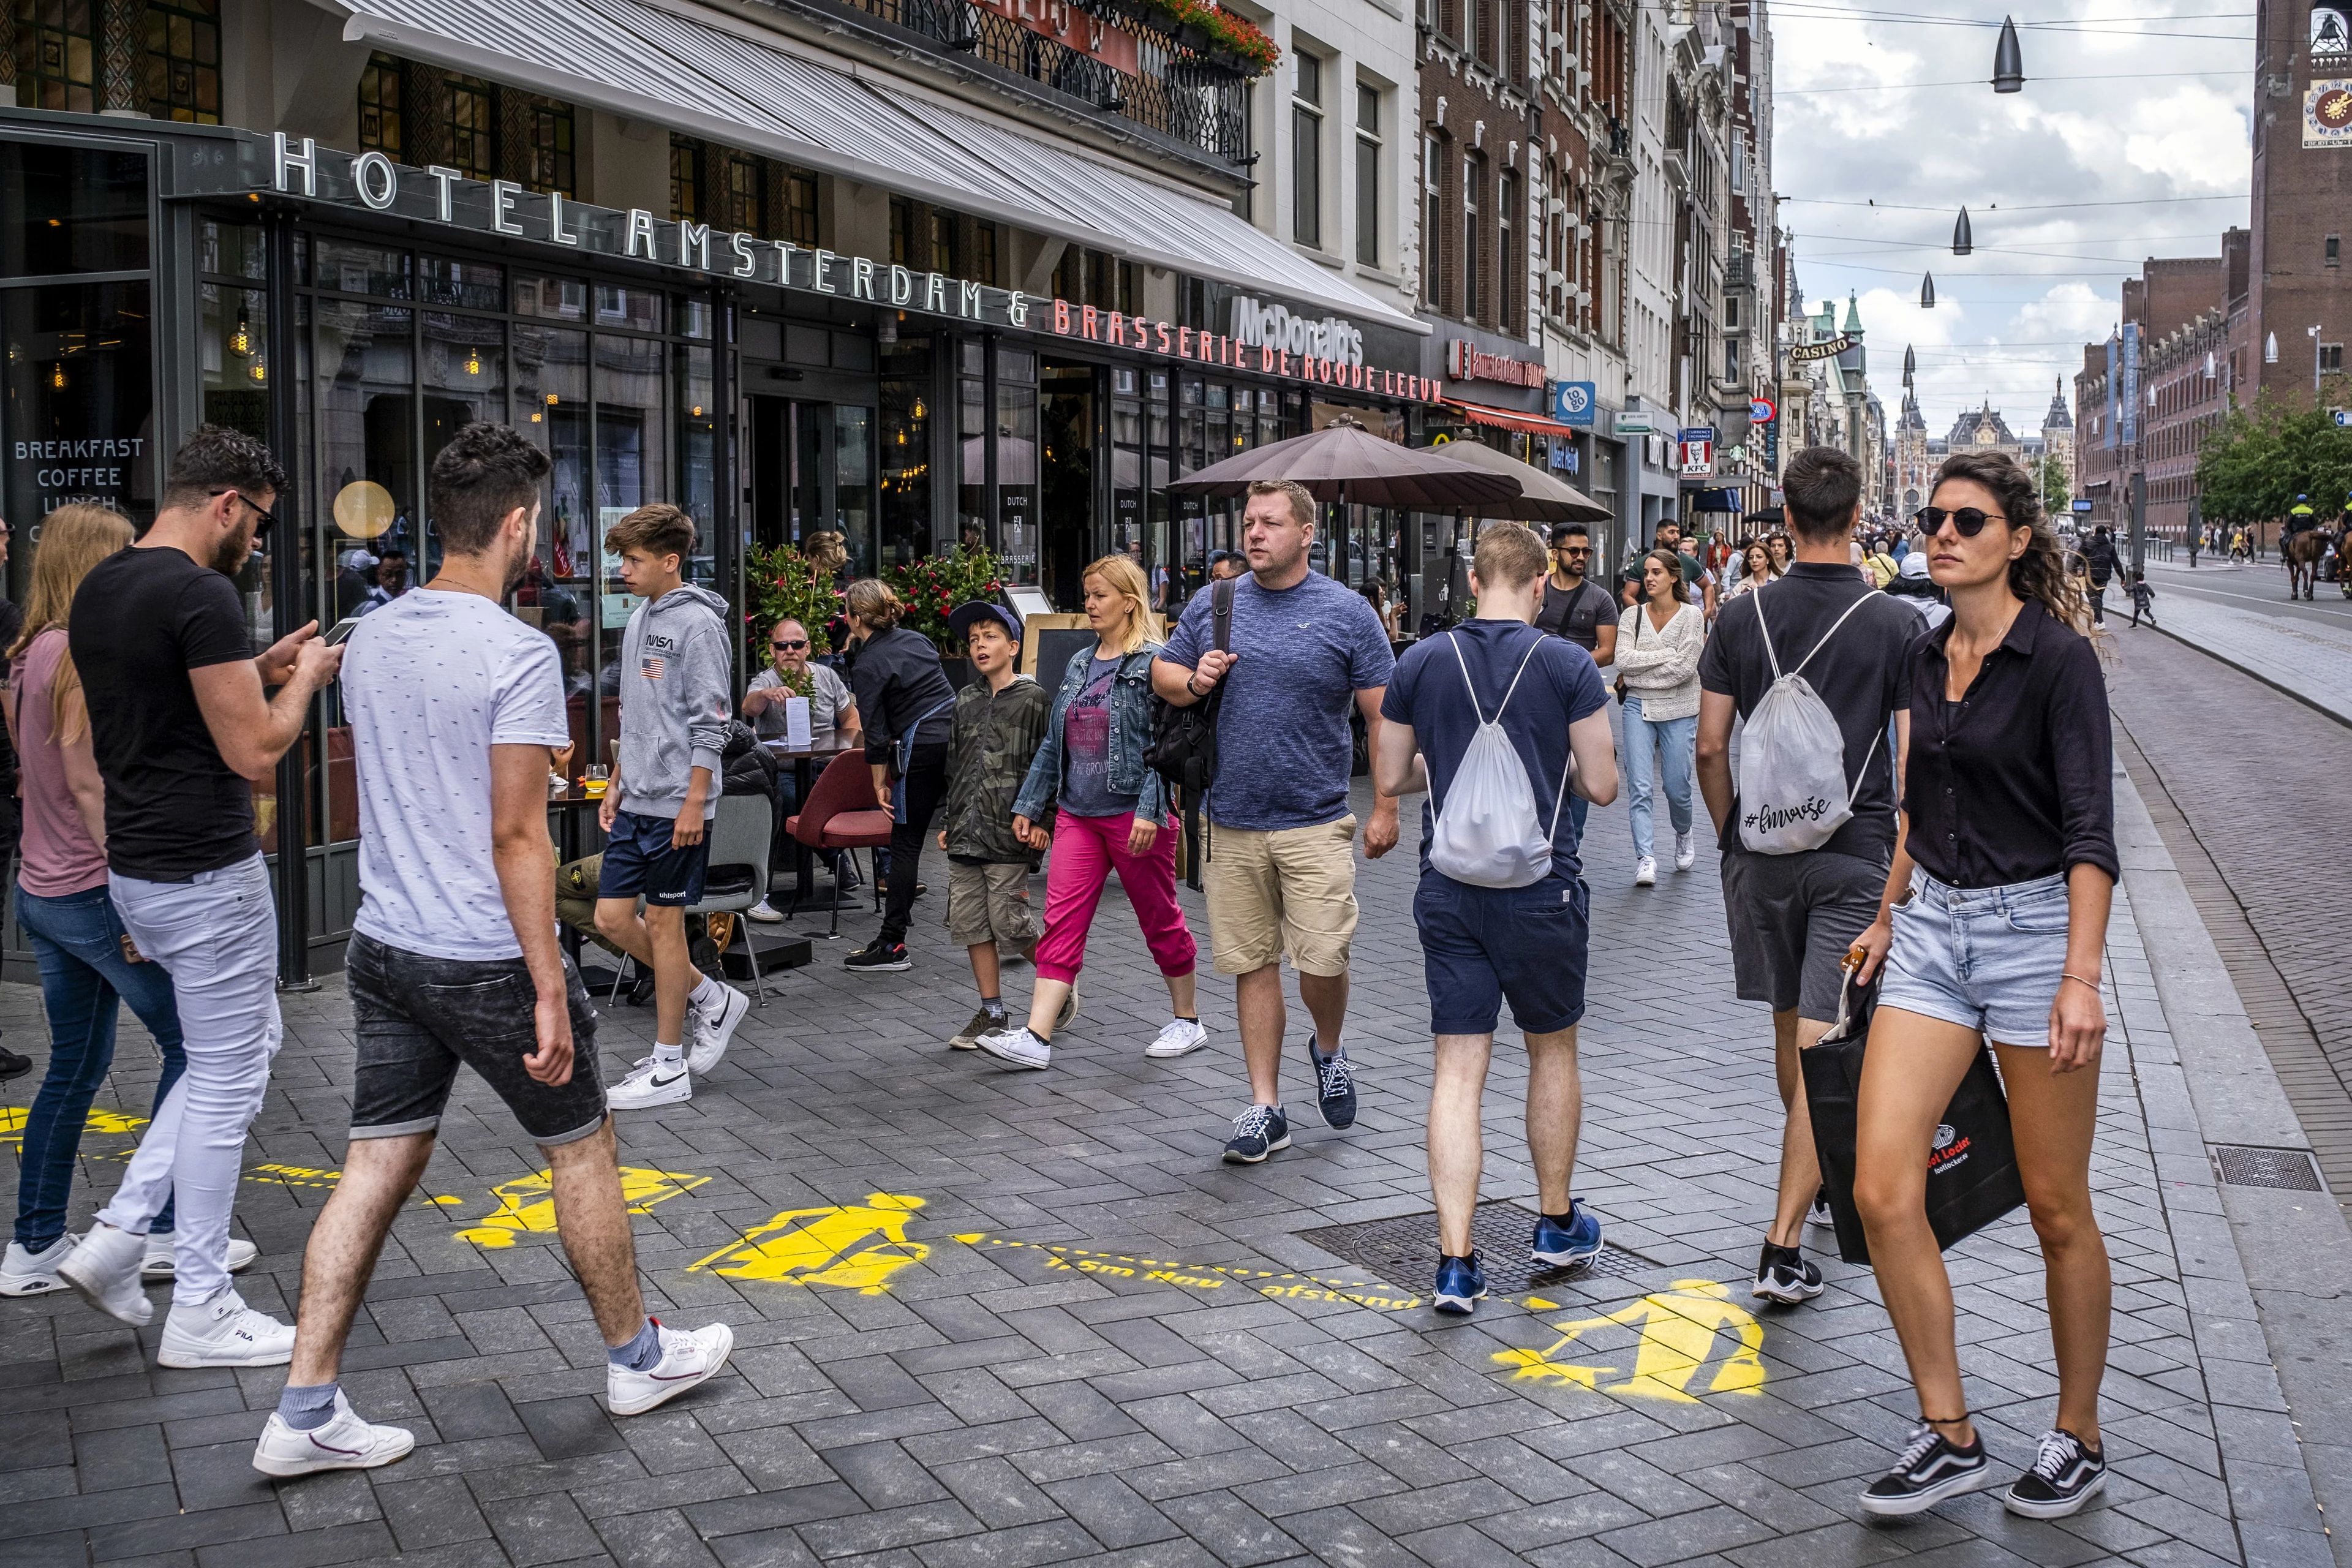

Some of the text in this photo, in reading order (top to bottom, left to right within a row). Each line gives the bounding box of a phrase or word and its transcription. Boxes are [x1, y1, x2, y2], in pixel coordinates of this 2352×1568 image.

[271, 131, 1441, 404] HOTEL AMSTERDAM & BRASSERIE DE ROODE LEEUW
[1230, 296, 1363, 366] McDonald's
[1792, 339, 1847, 359] CASINO
[1474, 352, 1547, 389] amsterdam TODAY
[1567, 390, 1580, 400] to
[1570, 397, 1585, 410] go
[15, 439, 143, 459] BREAKFAST
[37, 468, 121, 487] COFFEE
[1007, 497, 1028, 506] DUTCH
[1120, 500, 1137, 508] DUTCH
[1001, 554, 1035, 564] BRASSERIE
[646, 635, 673, 650] NASA
[1095, 728, 1105, 741] AND
[1072, 761, 1084, 775] THE
[659, 891, 686, 899] uhlsport
[1928, 1153, 1941, 1168] oot
[1259, 1284, 1422, 1310] afstand
[235, 1329, 254, 1341] FILA
